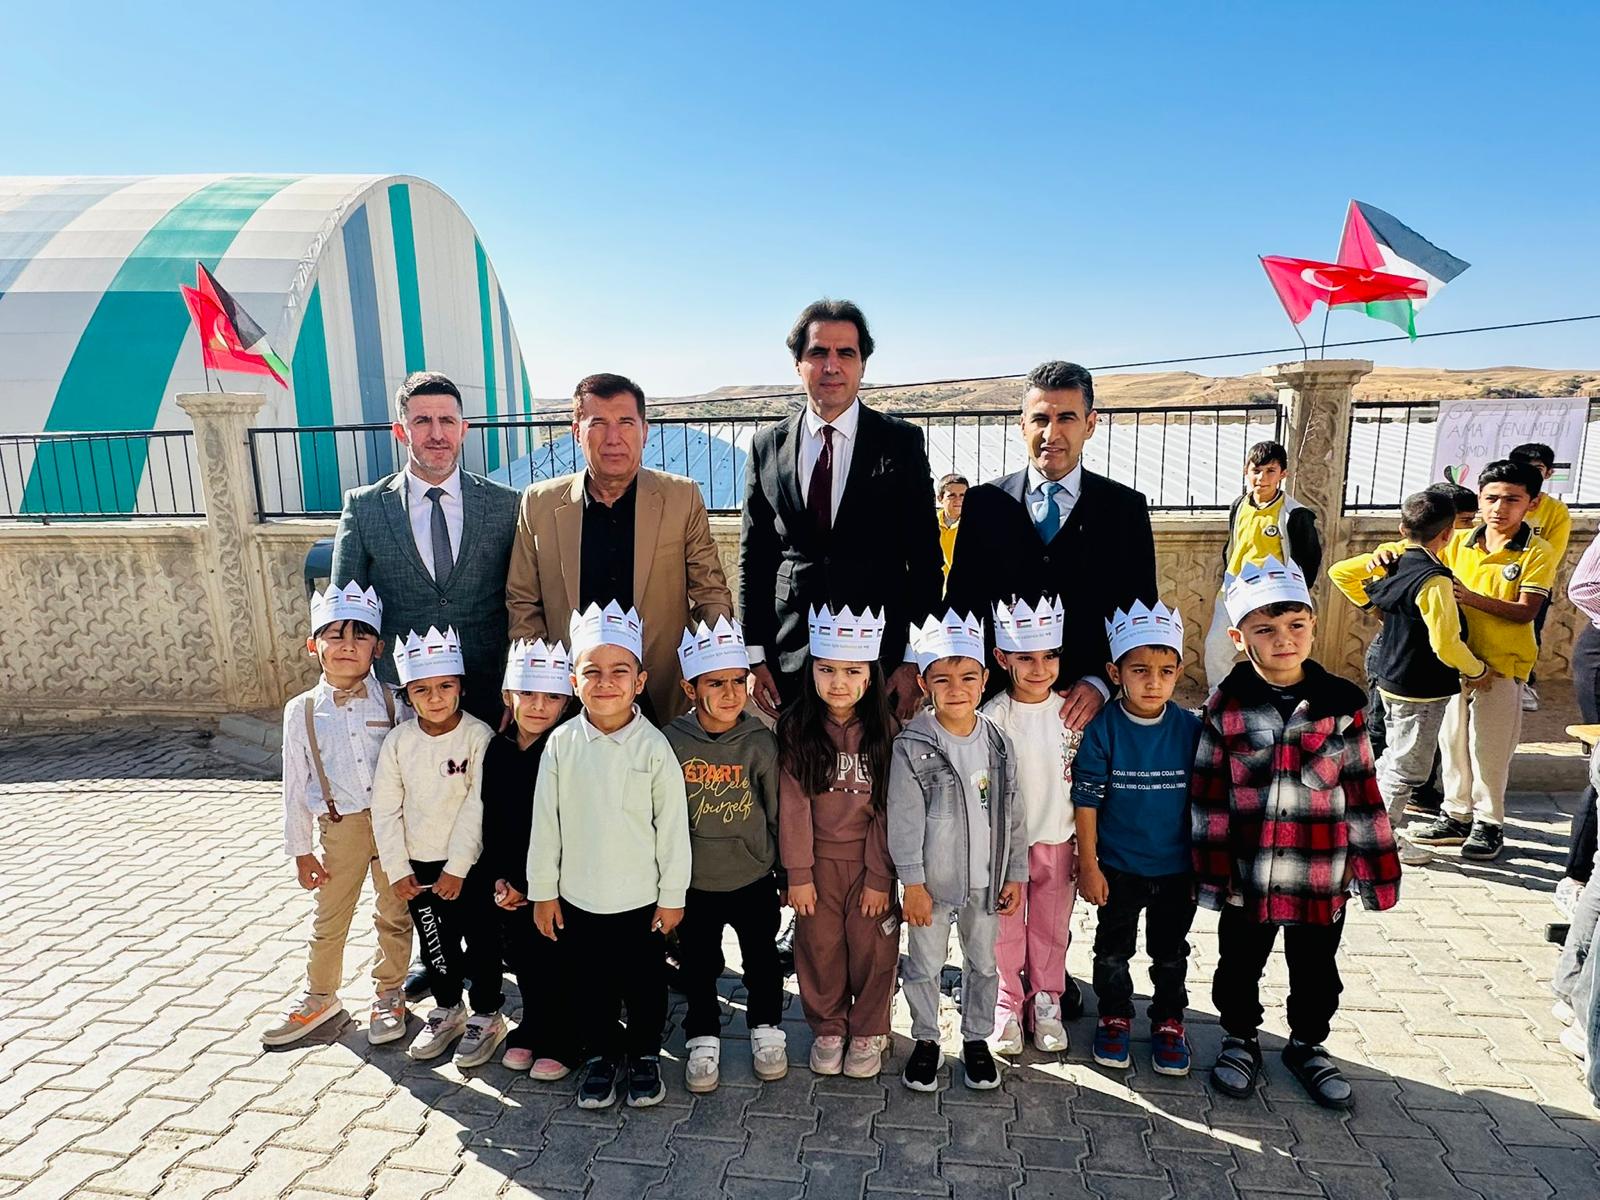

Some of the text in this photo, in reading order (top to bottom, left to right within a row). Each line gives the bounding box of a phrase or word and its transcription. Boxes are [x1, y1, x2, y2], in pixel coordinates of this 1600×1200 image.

[1447, 402, 1516, 419] GAZZE
[1447, 422, 1483, 438] AMA
[684, 763, 743, 784] START
[418, 905, 446, 966] POSITIE
